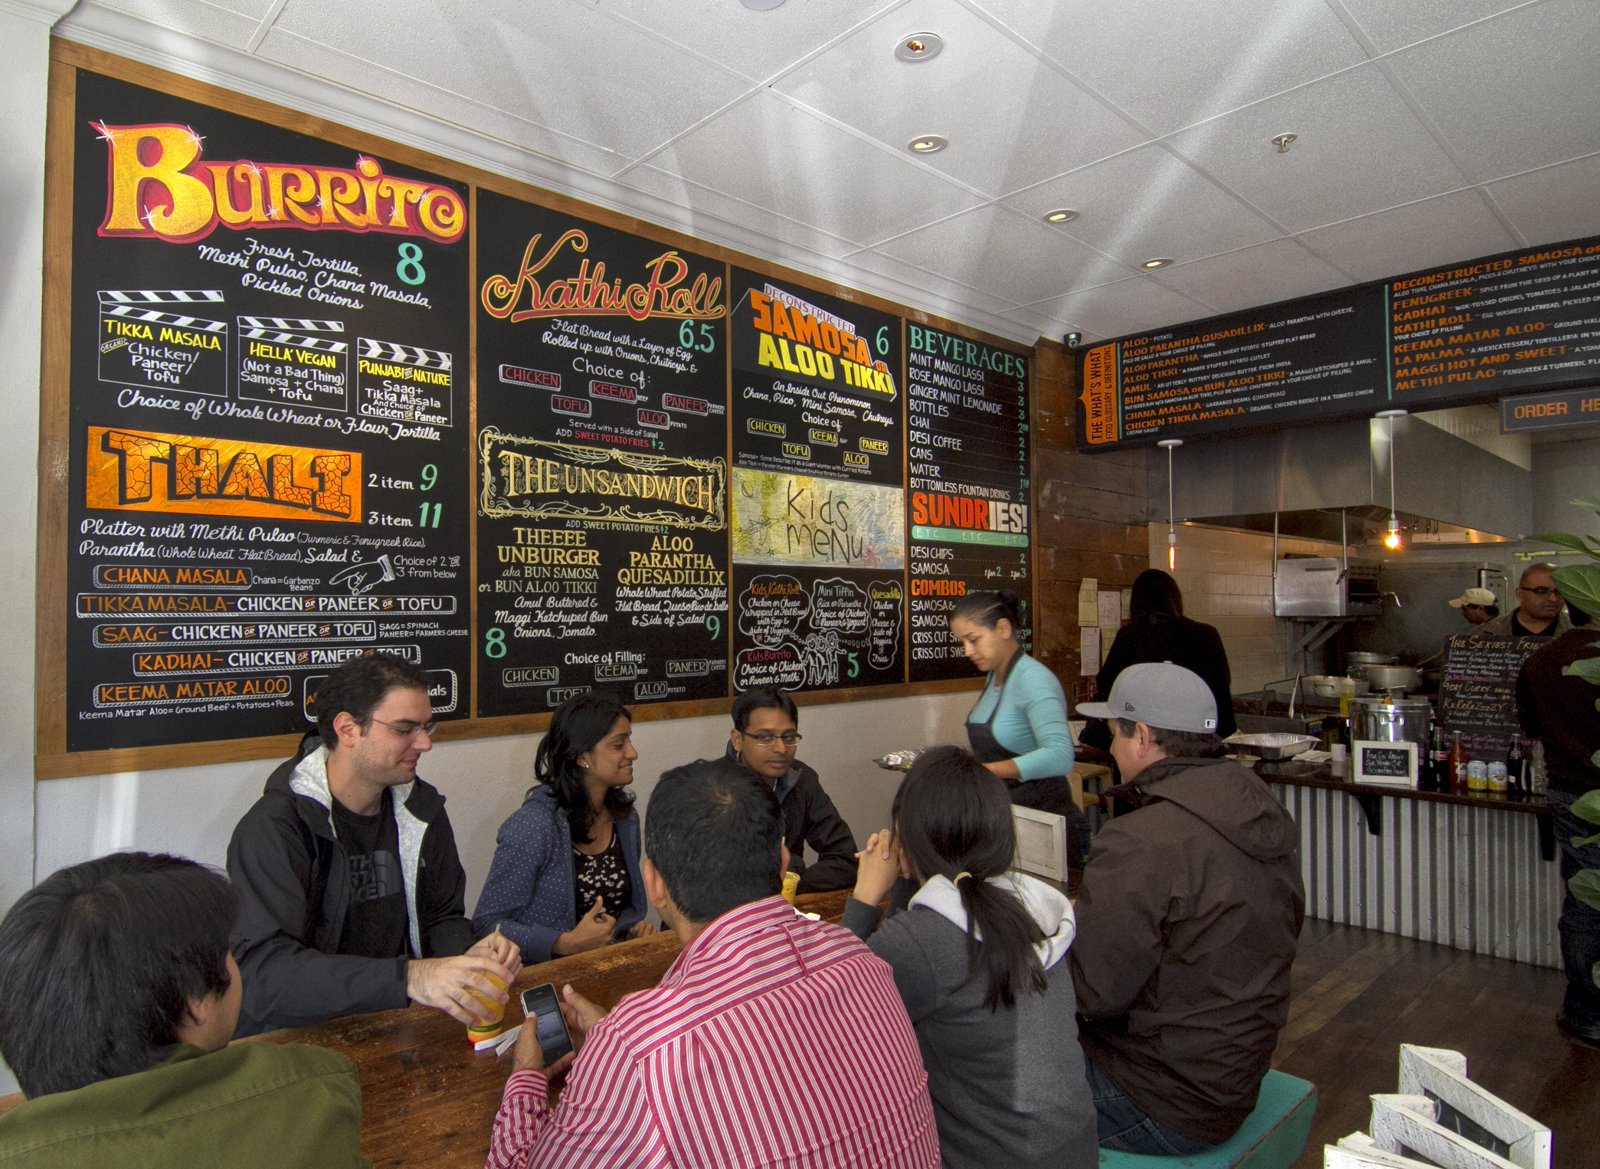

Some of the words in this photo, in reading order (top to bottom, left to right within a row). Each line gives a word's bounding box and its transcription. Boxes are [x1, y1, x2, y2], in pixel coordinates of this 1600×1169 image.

[243, 238, 295, 262] Fresh
[298, 250, 362, 277] Tortilla,
[397, 243, 426, 285] 8
[198, 245, 249, 268] Methi
[256, 258, 309, 283] Pulao,
[315, 271, 365, 294] Chana
[369, 282, 432, 309] Masala,
[482, 229, 625, 318] Kathi
[624, 251, 726, 321] Roll
[1393, 259, 1512, 291] DECONSTRUCTED
[1518, 247, 1581, 265] SAMOSA
[242, 273, 302, 297] Pickled
[308, 288, 363, 309] Onions
[1393, 287, 1473, 309] FENUGREEK
[765, 285, 855, 333] DECONSTRUCTED
[1393, 305, 1446, 322] KADHAI
[750, 290, 871, 366] SAMOSA
[1394, 319, 1435, 334] KATHI
[1439, 313, 1472, 327] ROLL
[103, 320, 153, 340] TIKKA
[160, 328, 221, 351] MASALA
[679, 320, 715, 353] 6.5
[876, 326, 889, 355] 6
[1394, 337, 1444, 353] KEEMA
[1449, 328, 1500, 344] MATAR
[1505, 322, 1545, 336] ALOO
[128, 342, 199, 363] Chicken/
[910, 325, 1024, 378] BEVERAGES
[1123, 348, 1148, 358] ALOO
[1150, 336, 1200, 353] PARANTHA
[1395, 355, 1411, 365] LA
[1416, 348, 1464, 362] PALMA
[132, 355, 193, 375] Paneer/
[573, 358, 624, 379] Choice
[758, 333, 835, 380] ALOO
[840, 358, 895, 394] TIKKI
[910, 352, 932, 367] MINT
[934, 358, 960, 375] MANGO
[962, 366, 984, 381] LASSI
[1090, 352, 1100, 378] WHAT
[1396, 364, 1444, 378] MAGGI
[1448, 359, 1476, 370] HOT
[1480, 354, 1510, 365] AND
[1515, 346, 1567, 360] SWEET
[143, 370, 180, 384] Tofu
[359, 360, 404, 378] PUNJABI
[413, 371, 451, 386] NATURE
[505, 367, 558, 386] CHICKEN
[910, 368, 931, 383] ROSE
[933, 374, 960, 390] MANGO
[963, 382, 984, 397] LASSI
[1396, 377, 1443, 391] METHI
[1448, 369, 1496, 382] PULAO
[593, 384, 636, 400] KEEMA
[909, 384, 938, 400] GINGER
[940, 391, 960, 405] MINT
[963, 396, 1002, 415] LEMONADE
[1091, 382, 1101, 421] WHAT'S
[118, 389, 180, 408] Choice
[185, 398, 206, 420] of
[209, 401, 264, 420] Whole
[267, 408, 321, 426] Wheat
[324, 419, 342, 429] or
[342, 416, 388, 436] Flour
[388, 422, 440, 441] Tortilla
[555, 397, 588, 413] TOFU
[666, 397, 706, 412] PANEER
[910, 399, 949, 417] BOTTLES
[1125, 408, 1156, 420] CHANA
[1159, 402, 1201, 415] MASALA
[1514, 402, 1568, 419] ORDER
[640, 412, 667, 425] ALOO
[750, 420, 784, 435] CHICKEN
[910, 415, 929, 429] CHAI
[556, 428, 572, 436] ADD
[575, 430, 599, 441] SWEET
[601, 433, 627, 445] POTATO
[629, 437, 649, 448] FRIES
[812, 431, 837, 443] KEEMA
[910, 431, 930, 444] DESI
[933, 435, 962, 451] COFFEE
[1092, 424, 1102, 441] THE
[785, 444, 808, 456] TOFU
[862, 439, 887, 452] PANEER
[910, 447, 933, 460] CANS
[845, 454, 867, 464] ALOO
[910, 462, 940, 477] WATER
[100, 430, 351, 519] THALI
[368, 474, 378, 487] 2
[381, 476, 414, 490] item
[420, 463, 438, 491] 9
[498, 450, 559, 497] THE
[564, 466, 715, 514] UNSANDWICH
[911, 478, 957, 493] BOTTOMLESS
[959, 484, 990, 497] FOUNTAIN
[990, 488, 1010, 500] DRINKS
[368, 511, 378, 525] 3
[381, 514, 413, 527] item
[419, 502, 442, 528] 11
[788, 480, 849, 532] Kids
[912, 492, 1027, 533] SUNDRIES!
[81, 519, 146, 537] Platter
[150, 523, 185, 538] with
[189, 524, 244, 541] Methi
[249, 527, 296, 542] Pulao
[513, 527, 587, 547] THEEEE
[651, 536, 693, 551] ALOO
[911, 547, 929, 558] DESI
[930, 547, 953, 559] CHIPS
[497, 546, 601, 566] UNBURGER
[630, 552, 715, 570] PARANTHA
[104, 567, 170, 584] CHANA
[176, 568, 248, 584] MASALA
[502, 568, 520, 577] aka
[524, 567, 551, 578] BUN
[554, 567, 599, 579] SAMOSA
[618, 569, 725, 586] QUESADILLIX
[911, 562, 949, 575] SAMOSA
[479, 584, 491, 592] or
[495, 580, 522, 592] BUN
[525, 582, 559, 593] ALOO
[563, 582, 597, 594] TIKKI
[818, 585, 832, 597] Mini
[911, 579, 966, 596] COMBOS
[81, 595, 144, 611] TIKKA
[237, 597, 302, 611] CHICKEN
[319, 598, 379, 610] PANEER
[396, 599, 442, 610] TOFU
[172, 625, 242, 640] CHICKEN
[259, 624, 317, 638] PANEER
[334, 624, 372, 635] TOFU
[707, 616, 720, 640] 9
[486, 627, 507, 658] 8
[847, 653, 860, 678] 5
[101, 685, 169, 702] KEEMA
[176, 681, 236, 698] MATAR
[243, 679, 287, 694] ALOO
